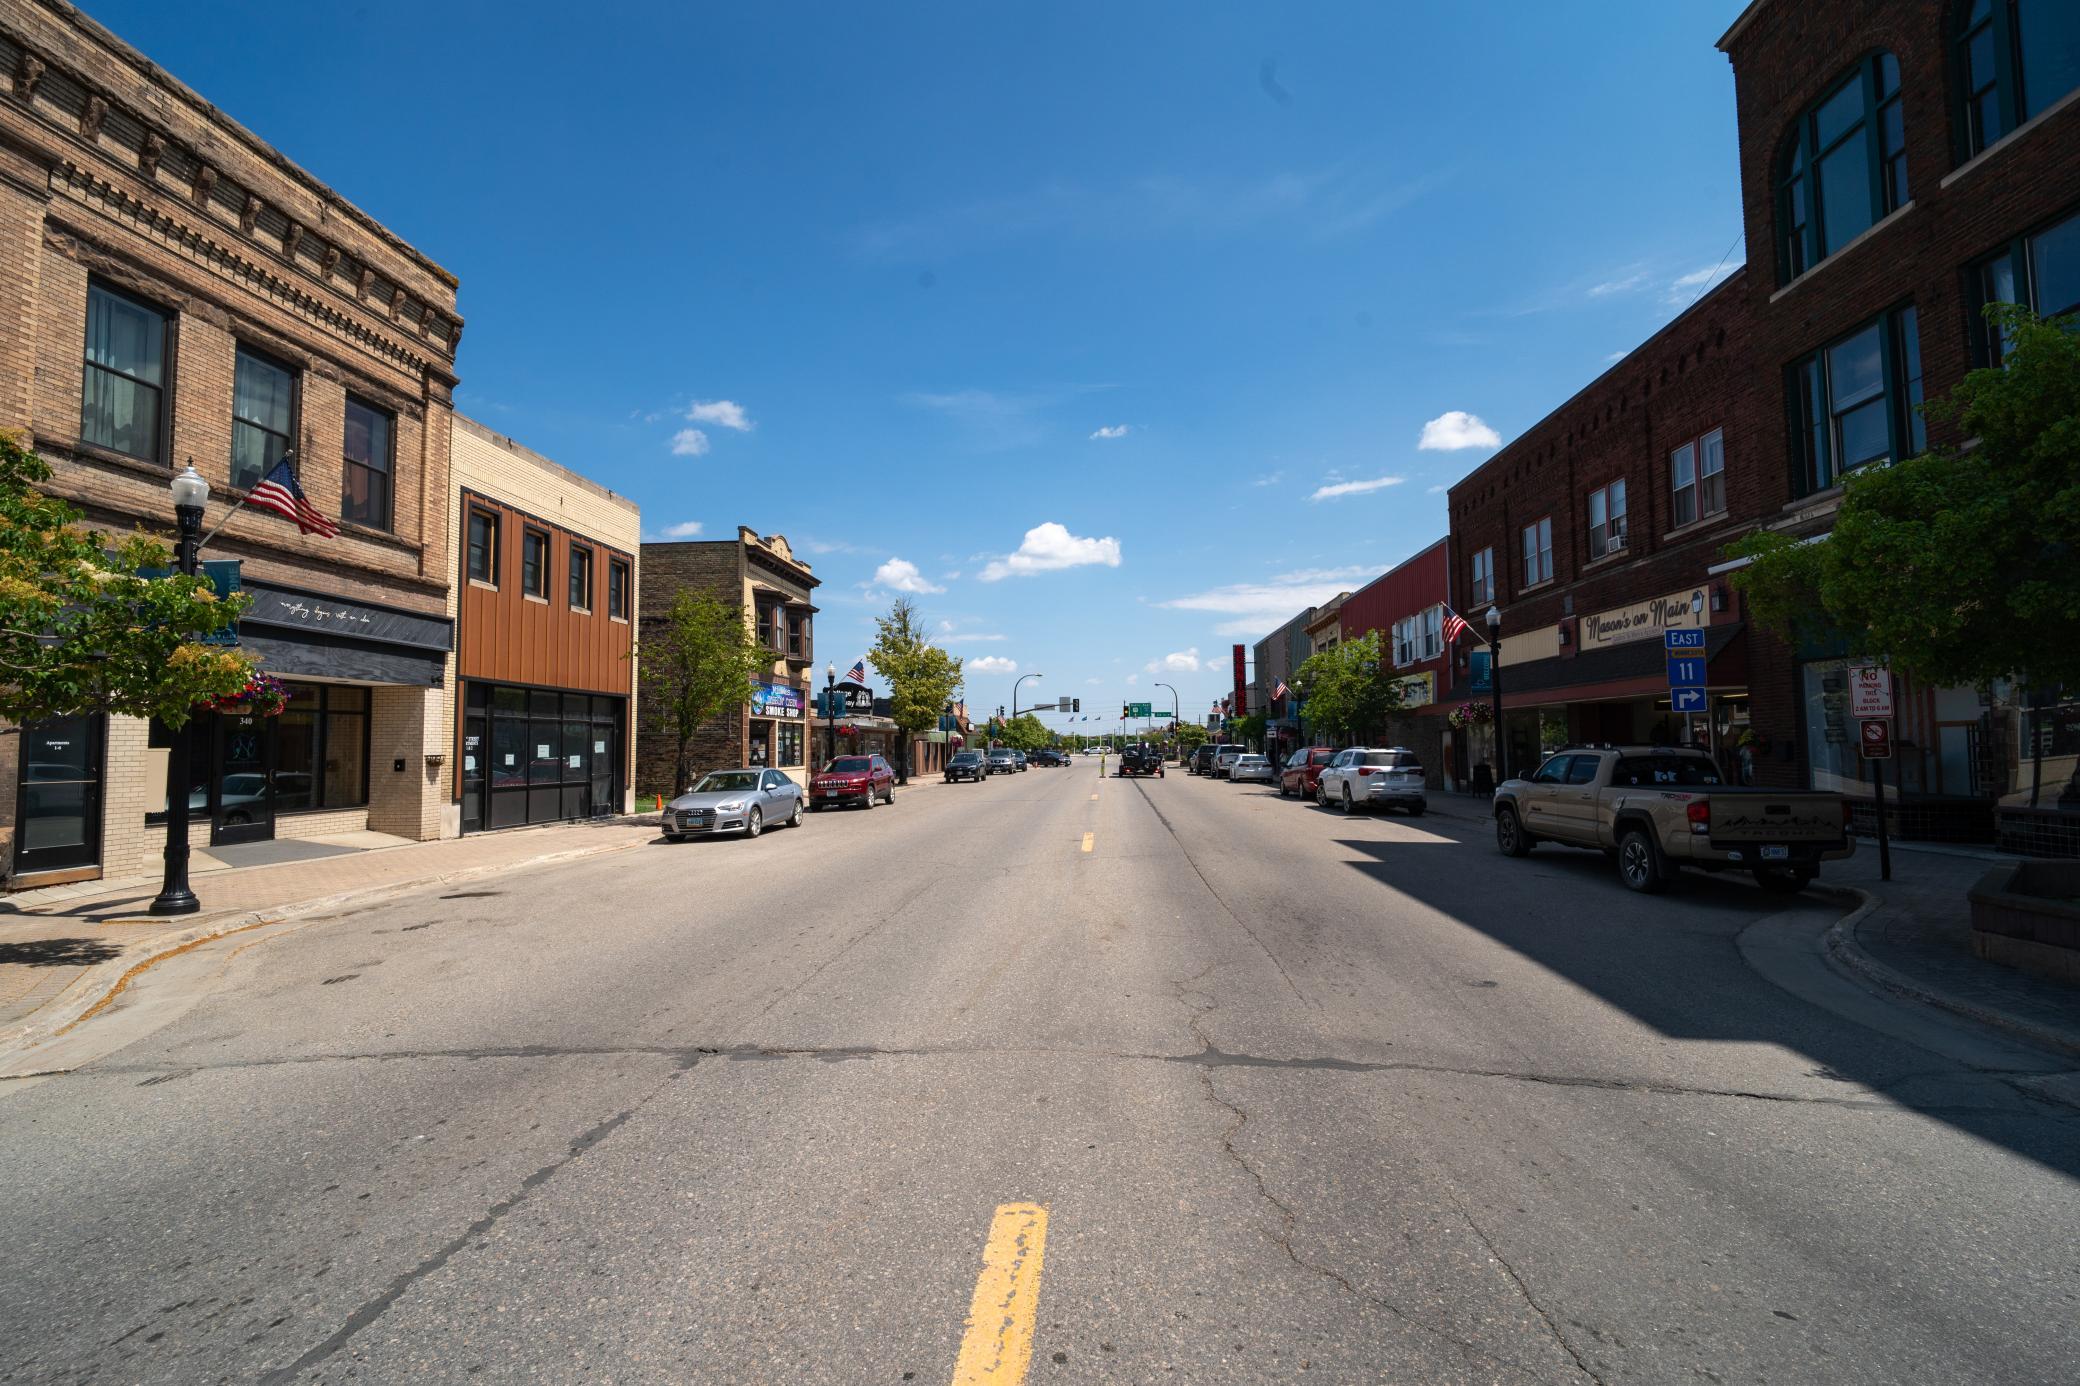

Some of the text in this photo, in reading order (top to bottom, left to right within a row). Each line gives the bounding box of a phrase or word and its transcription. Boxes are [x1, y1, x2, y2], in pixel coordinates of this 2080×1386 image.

[1586, 612, 1631, 642] Mason's
[1633, 612, 1649, 626] on
[1650, 599, 1690, 627] Main
[1671, 632, 1698, 645] EAST
[1680, 662, 1694, 680] 11
[1861, 672, 1877, 681] NO
[765, 705, 799, 718] SMOKE SHOP
[240, 717, 252, 725] 340
